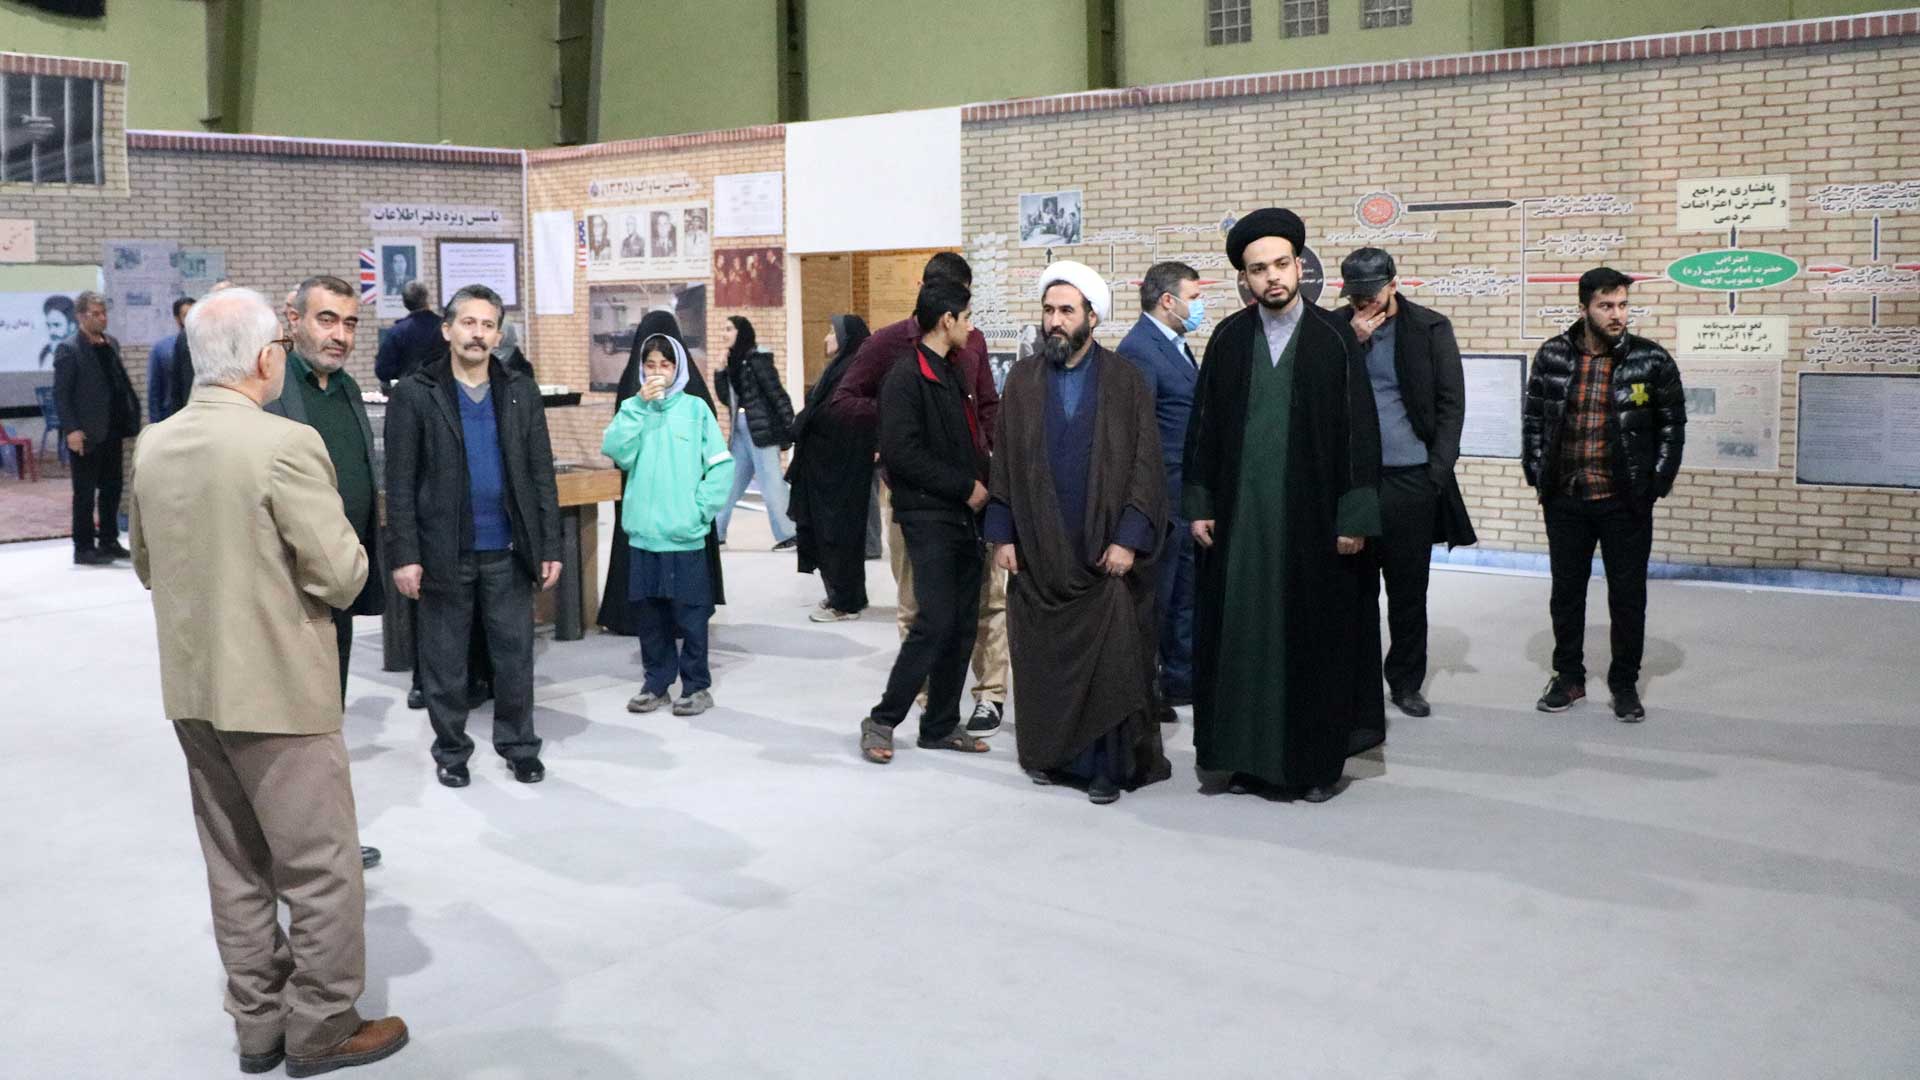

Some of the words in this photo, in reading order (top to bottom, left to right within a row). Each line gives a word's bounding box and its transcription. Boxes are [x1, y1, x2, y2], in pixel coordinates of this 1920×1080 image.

[1692, 186, 1726, 198] مراجع
[1730, 183, 1775, 196] پافشاری
[1681, 199, 1731, 211] اعتراضات
[1735, 197, 1776, 209] گسترش
[374, 207, 419, 221] اطلاعات
[420, 208, 441, 226] دفتر
[1714, 214, 1752, 224] مردمی
[1716, 255, 1749, 265] اعتراض
[1703, 267, 1731, 276] خمینی
[1733, 265, 1751, 275] امام
[1753, 266, 1783, 275] حضرت
[1750, 322, 1762, 330] لغو
[1724, 331, 1739, 341] آذر
[1757, 333, 1767, 341] در
[1741, 344, 1761, 352] سوی
[1764, 343, 1772, 352] از
